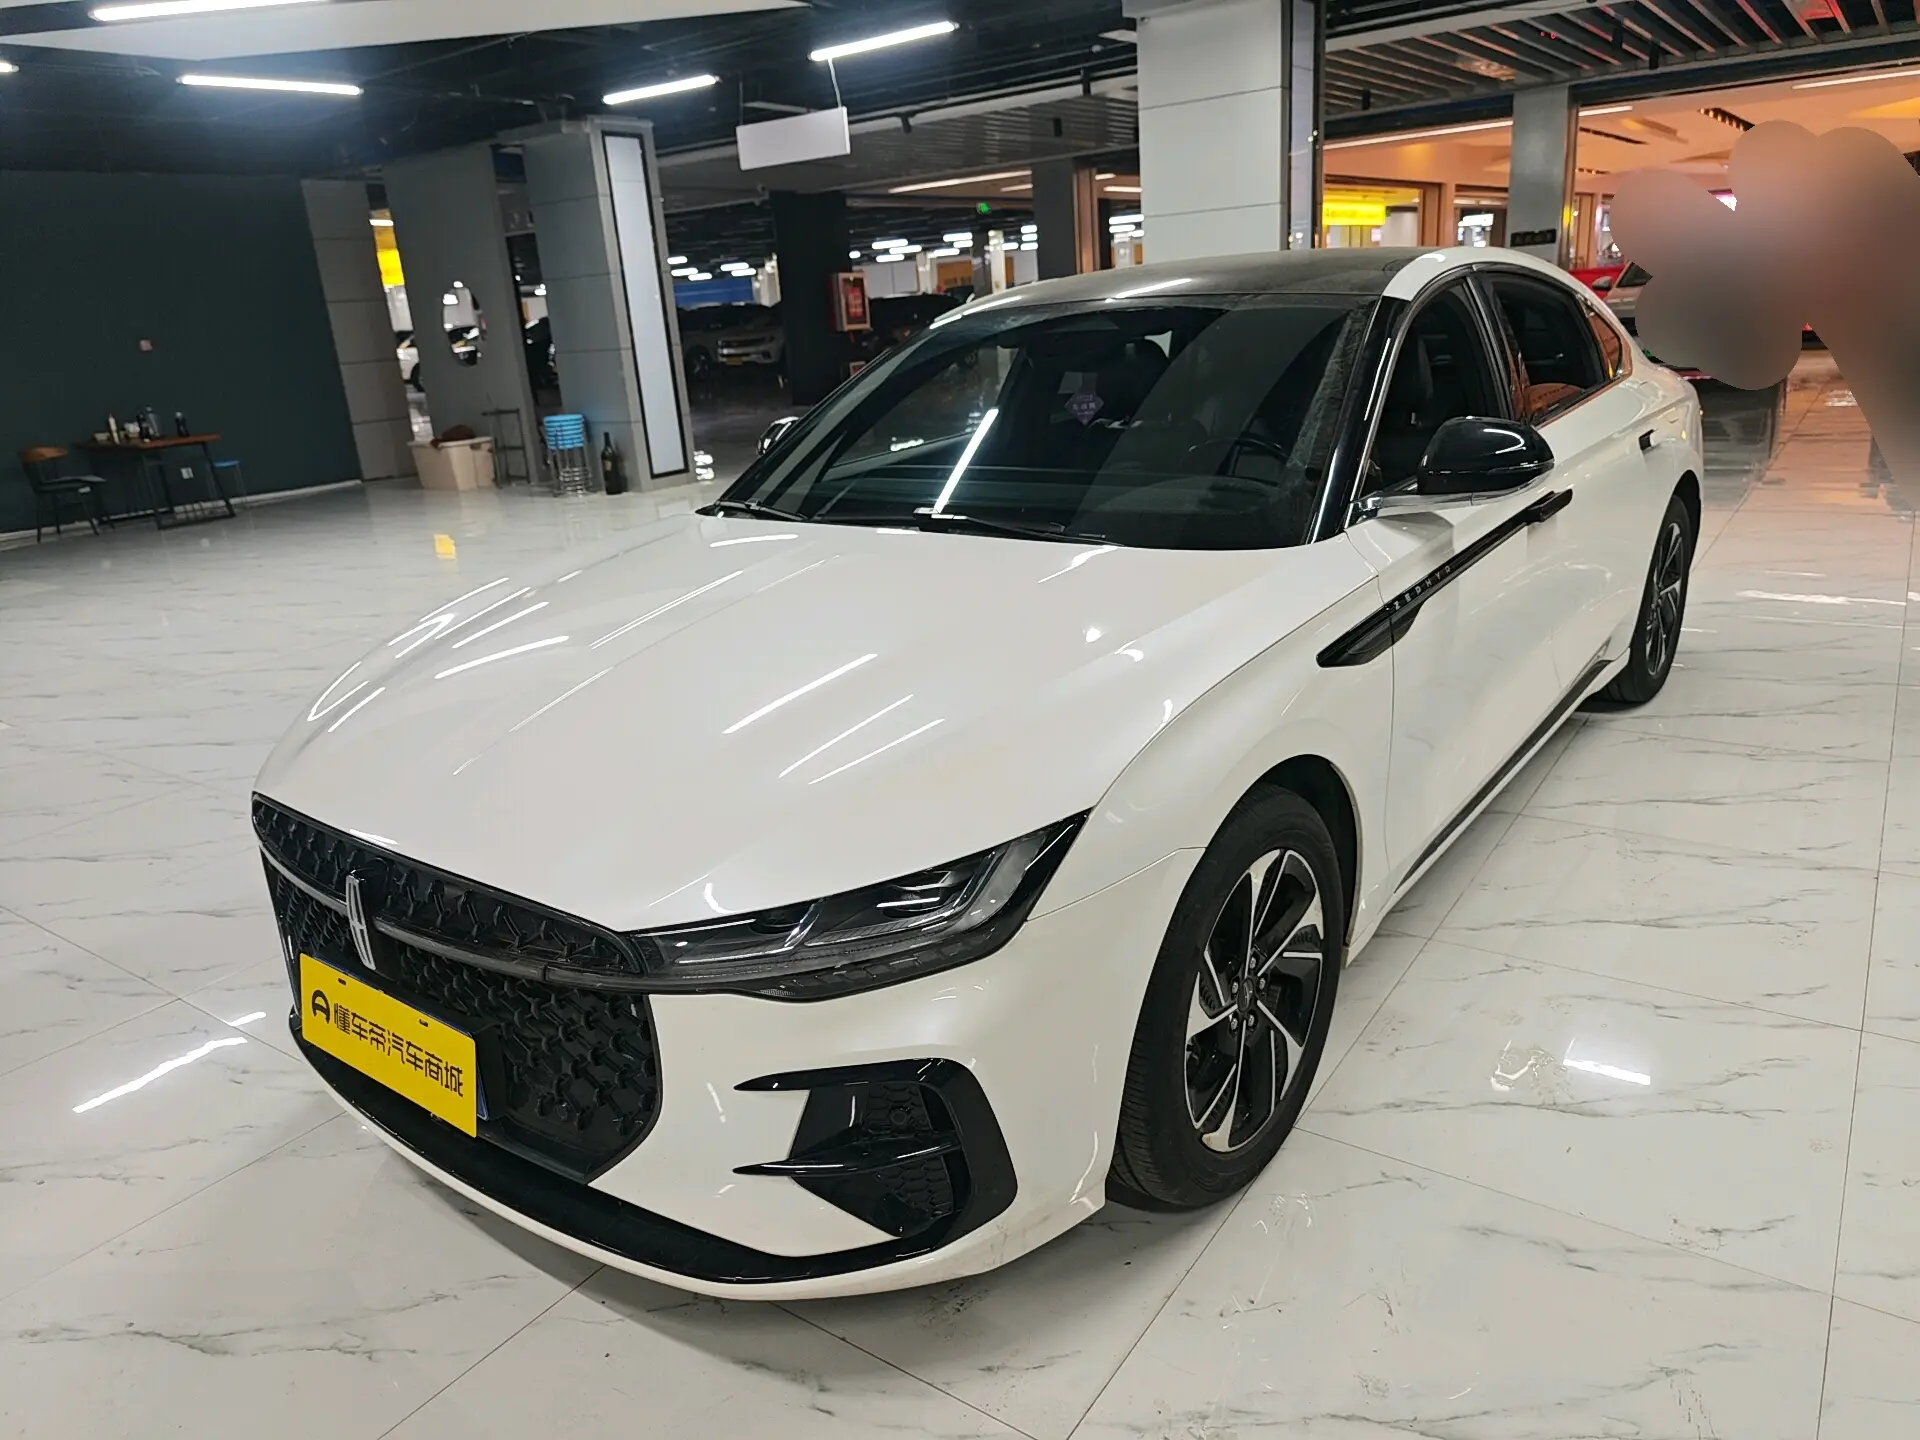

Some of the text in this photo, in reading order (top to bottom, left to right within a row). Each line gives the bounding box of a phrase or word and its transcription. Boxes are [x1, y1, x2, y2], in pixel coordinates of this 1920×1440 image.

[1394, 566, 1451, 610] ZEPHYR
[334, 1003, 463, 1097] 懂车帝汽车商城
